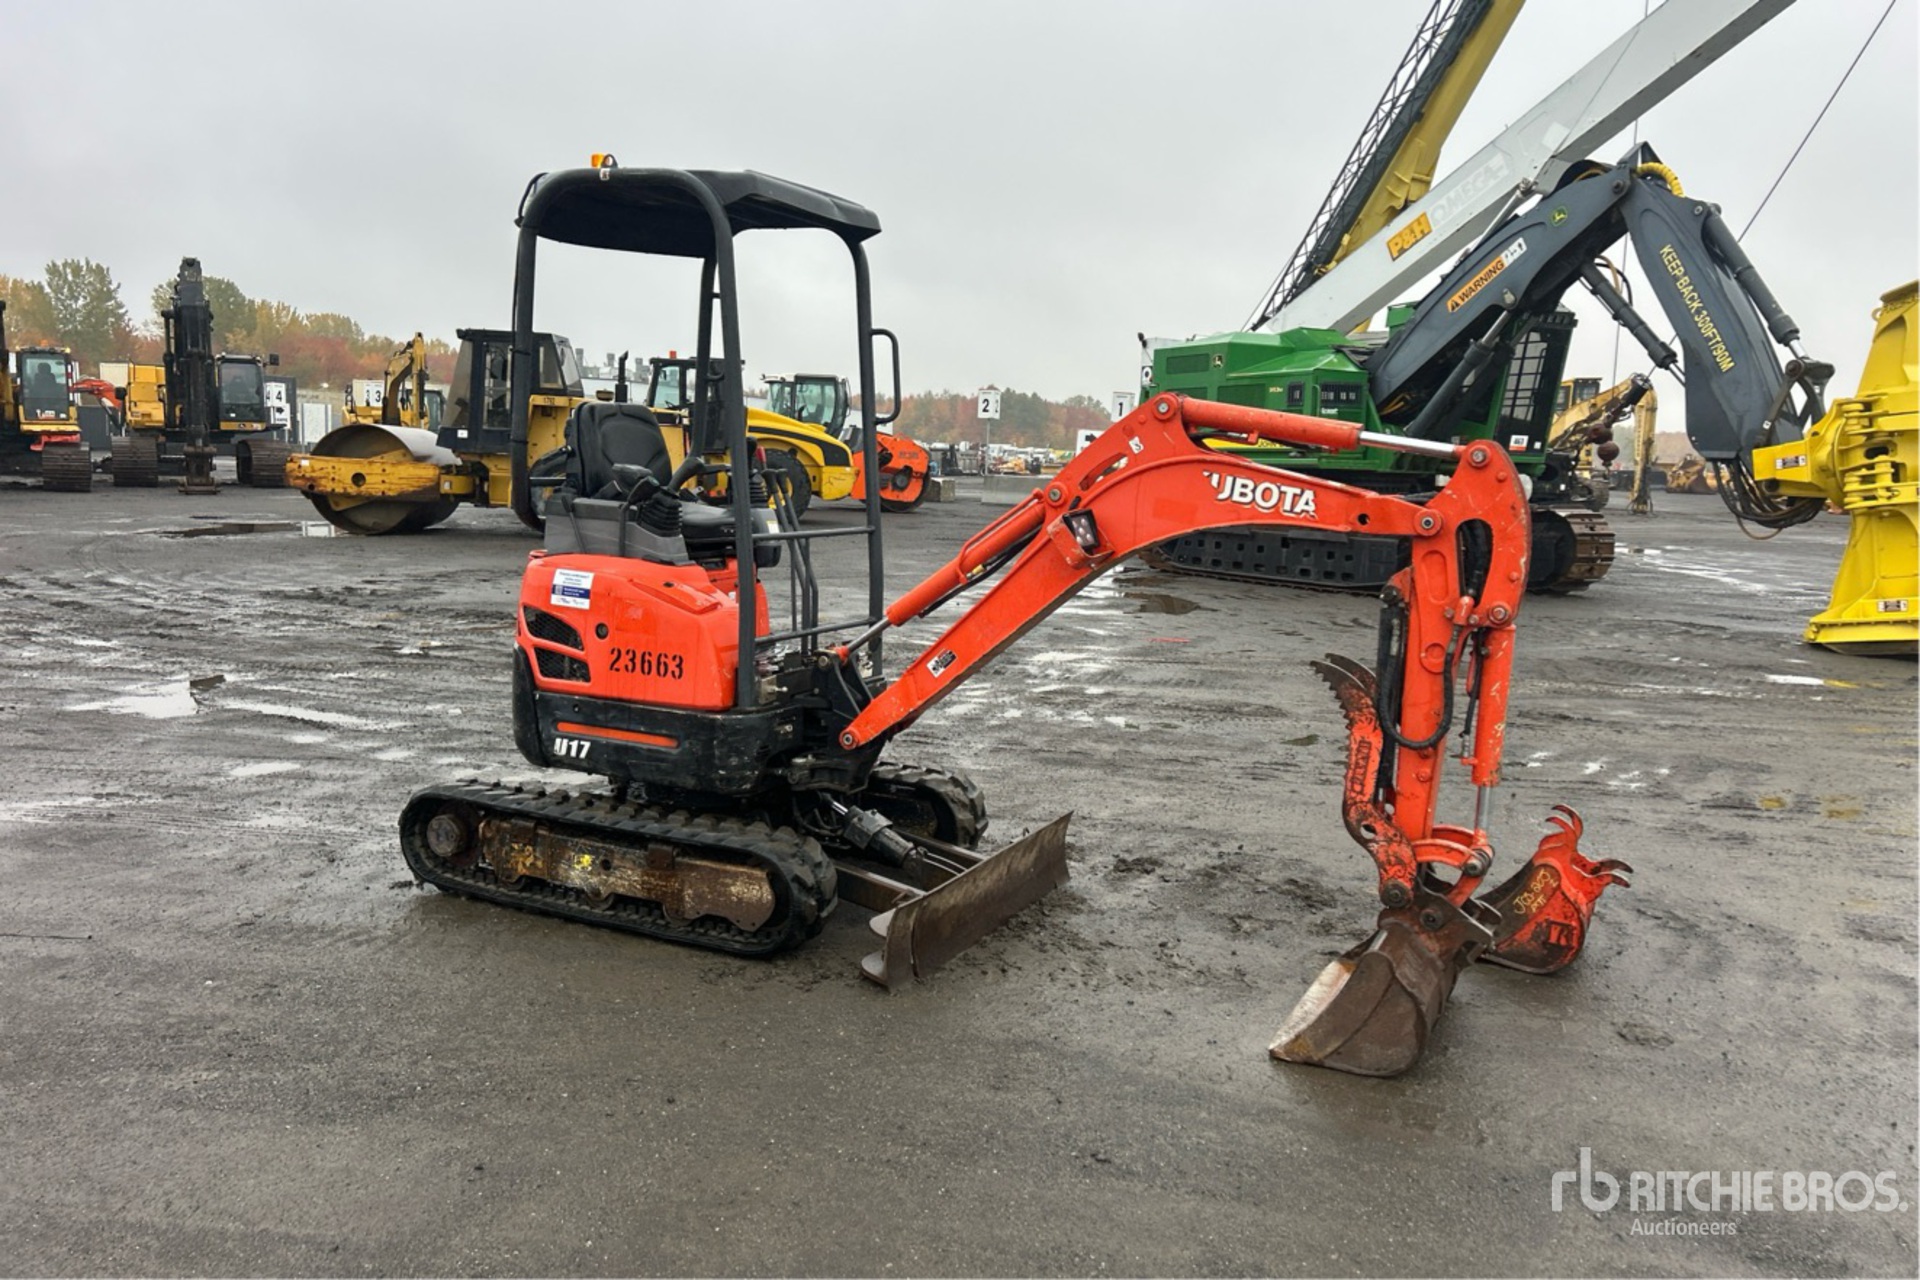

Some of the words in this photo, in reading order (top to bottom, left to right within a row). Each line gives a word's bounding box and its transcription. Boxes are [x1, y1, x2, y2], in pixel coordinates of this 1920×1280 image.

[1388, 213, 1431, 258] P&H
[1459, 259, 1504, 302] WARNING
[1660, 244, 1685, 276] KEEP
[1676, 276, 1704, 314] BACK
[1694, 310, 1735, 373] 300FT/90M
[275, 391, 282, 402] 4
[375, 390, 381, 402] 3
[982, 399, 990, 412] 2
[1119, 402, 1123, 416] 1
[1203, 468, 1317, 516] UBOTA
[609, 647, 684, 680] 23663
[553, 738, 591, 759] U17
